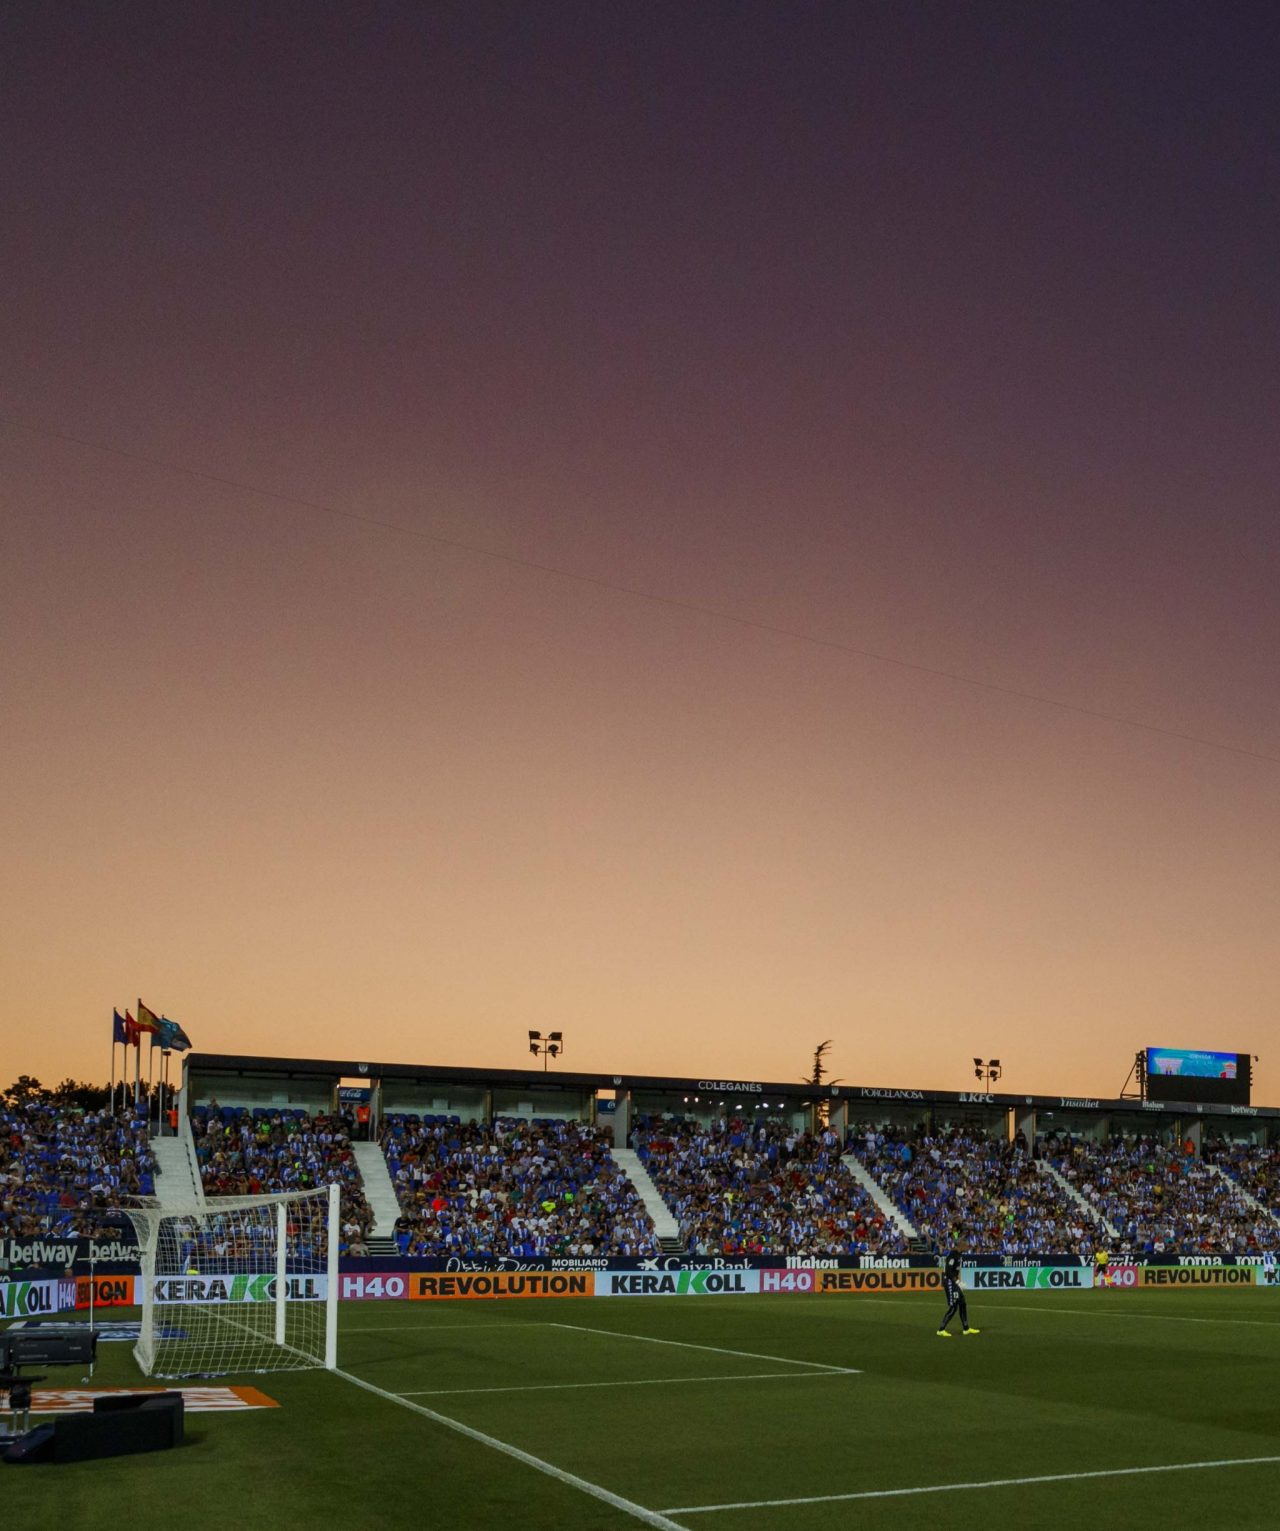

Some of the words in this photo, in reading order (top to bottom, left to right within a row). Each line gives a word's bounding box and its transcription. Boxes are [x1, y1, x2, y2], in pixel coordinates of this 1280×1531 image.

[861, 1087, 924, 1099] PORCELANOSA
[10, 1240, 78, 1268] betway
[552, 1259, 608, 1267] MOBILIARIO
[786, 1255, 839, 1269] Mahou
[859, 1255, 910, 1269] Mahou
[664, 1257, 753, 1271] CaixaBank
[419, 1275, 586, 1296] REVOLUTION
[611, 1270, 746, 1294] KERAKOLL
[763, 1272, 812, 1291] H40
[974, 1267, 1082, 1288] KERAKOLL
[1144, 1268, 1251, 1284] REVOLUTION
[154, 1274, 319, 1301] KERAKOLL
[343, 1276, 404, 1298] H40
